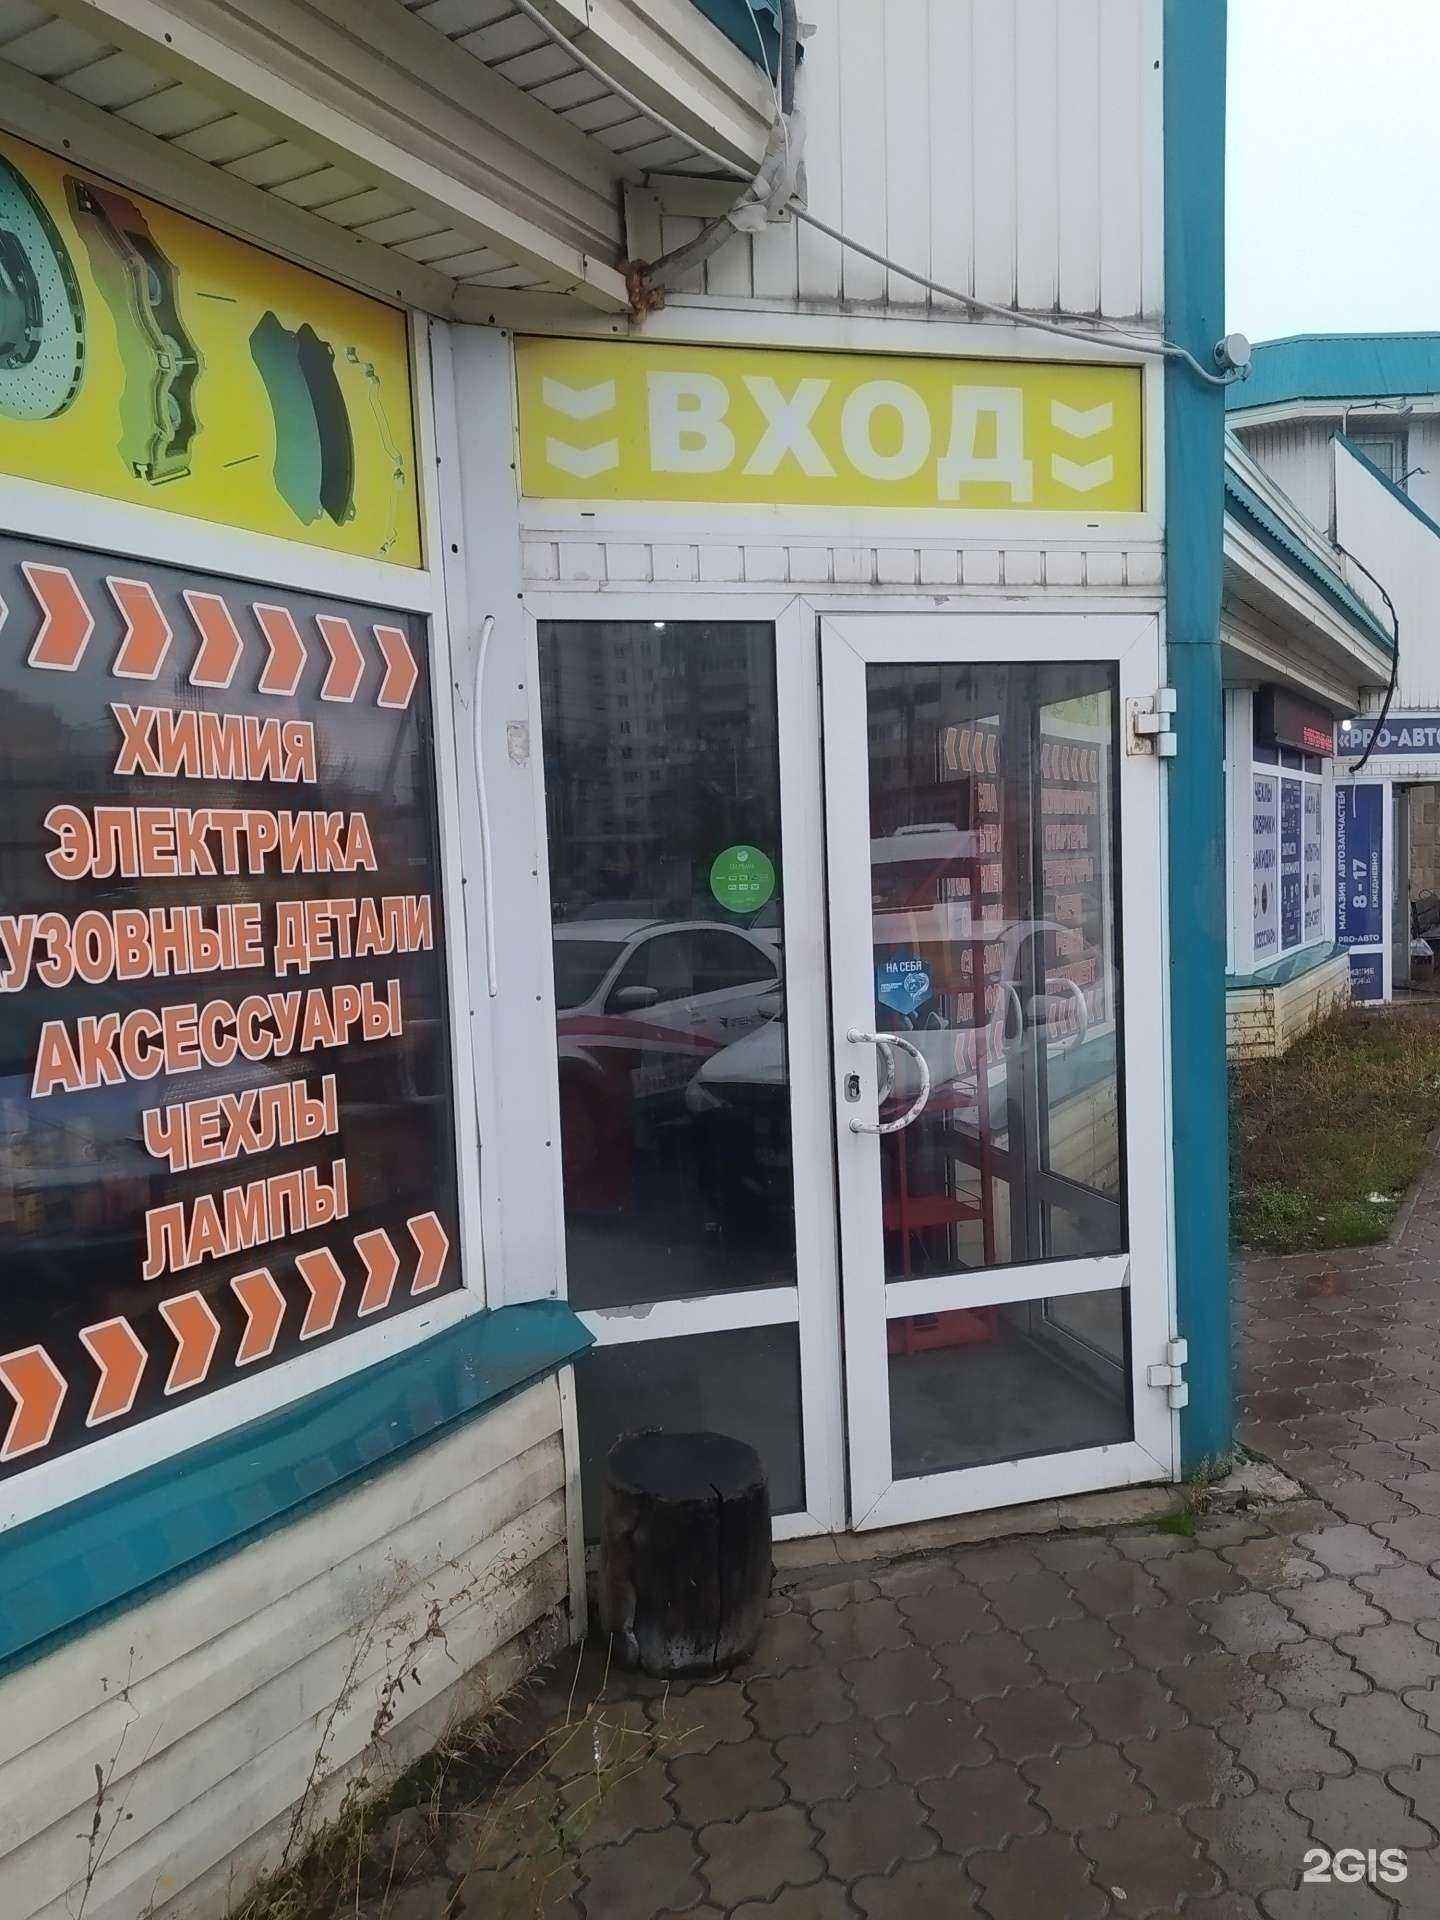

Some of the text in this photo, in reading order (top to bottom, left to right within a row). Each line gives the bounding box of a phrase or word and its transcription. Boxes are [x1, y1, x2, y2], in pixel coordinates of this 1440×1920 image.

[645, 371, 1034, 504] ВХОД
[111, 702, 317, 784] ХИМИЯ
[44, 804, 378, 881] ЭЛЕКТРИКА
[1336, 791, 1347, 930] МАГАЗИН АВТОЗАПЧАСТЕЙ
[0, 895, 434, 993] УЗОВНЫЕ ДЕТАЛИ
[886, 960, 922, 973] НА СЕБЯ
[31, 979, 402, 1099] АКСЕССУАРЫ
[142, 1074, 339, 1173] ЧЕХЛЫ
[143, 1158, 349, 1281] ЛАМПЫ
